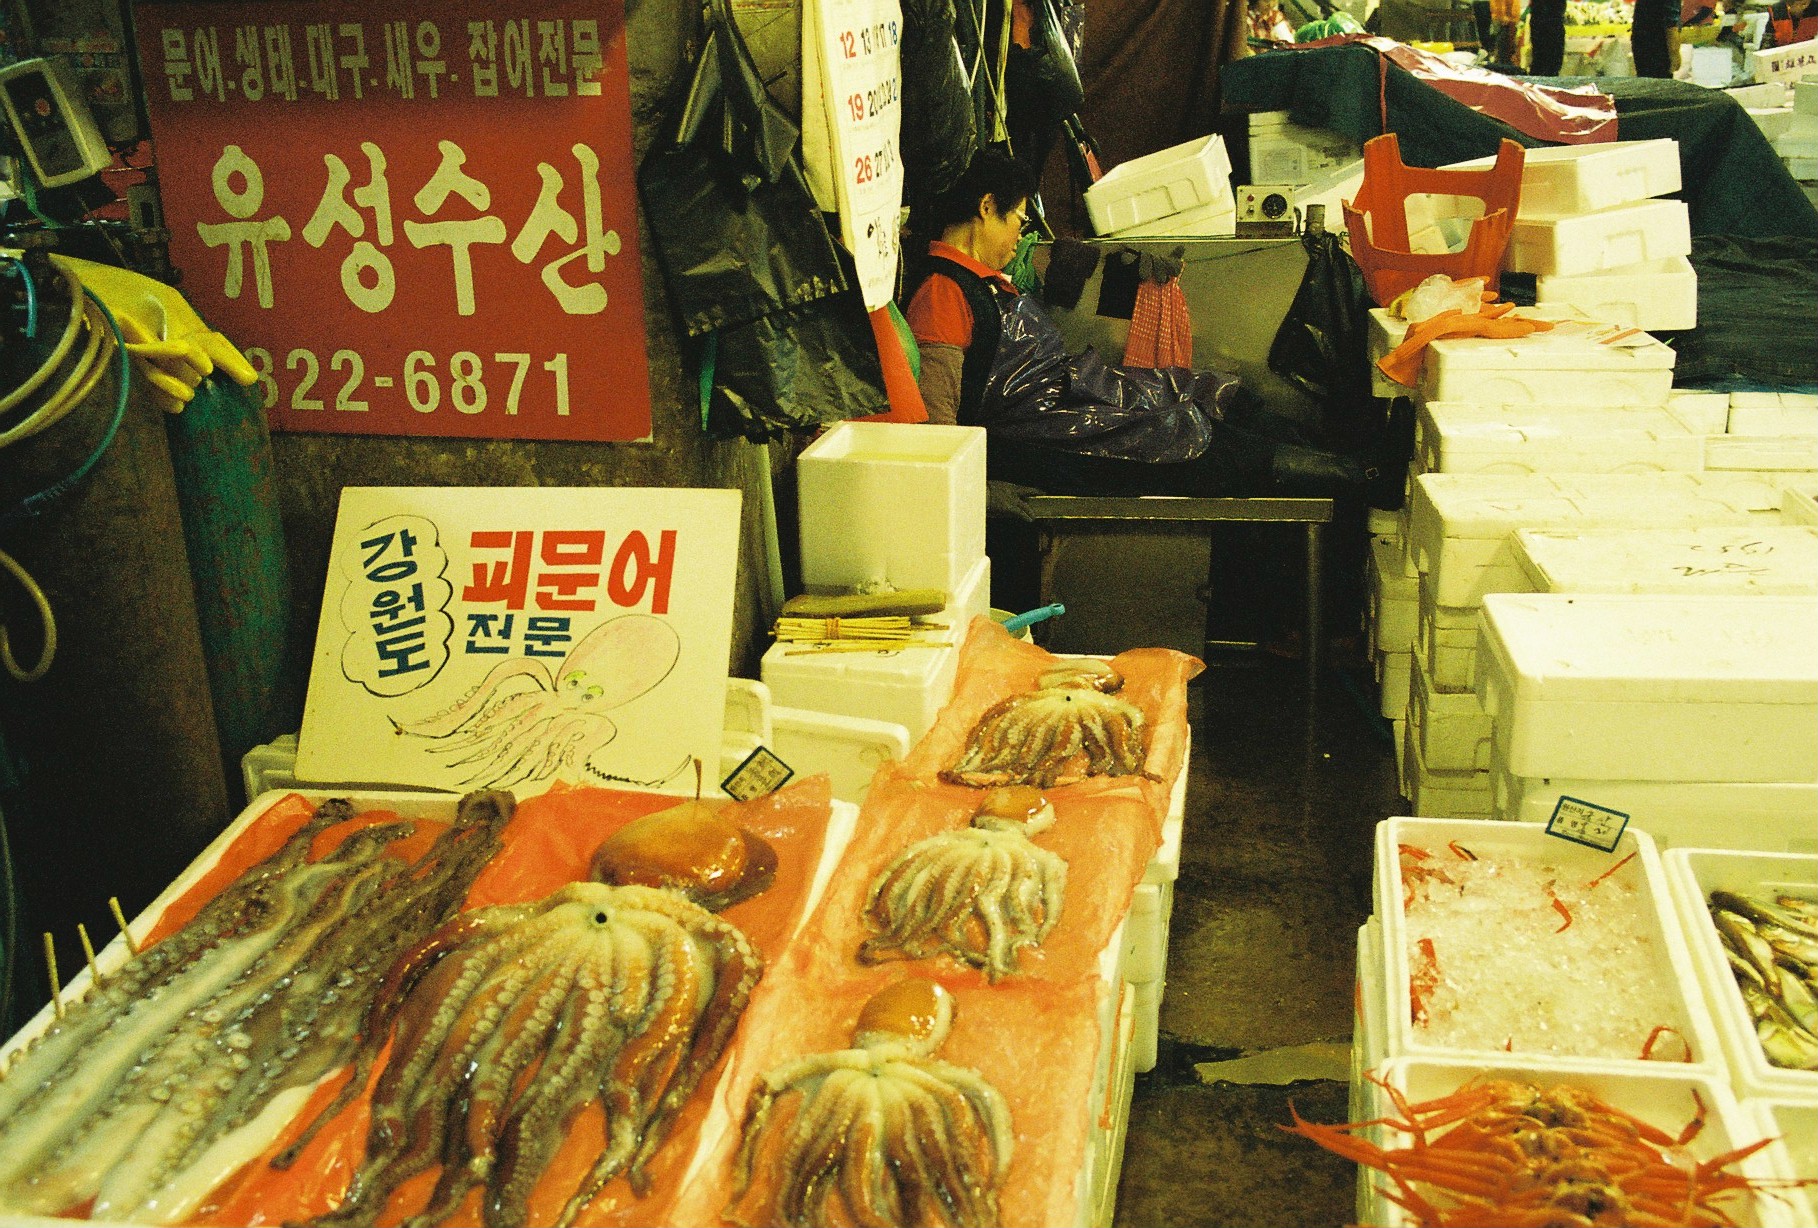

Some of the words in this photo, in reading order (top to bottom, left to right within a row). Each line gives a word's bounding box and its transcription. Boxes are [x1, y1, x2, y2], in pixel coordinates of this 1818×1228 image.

[840, 31, 856, 58] 12
[888, 21, 897, 46] 18
[848, 94, 864, 121] 19
[856, 155, 873, 184] 26
[197, 139, 622, 316] 유성수산
[245, 347, 571, 416] 822-6871
[361, 529, 430, 679] 강원도
[462, 529, 677, 614] 피문어
